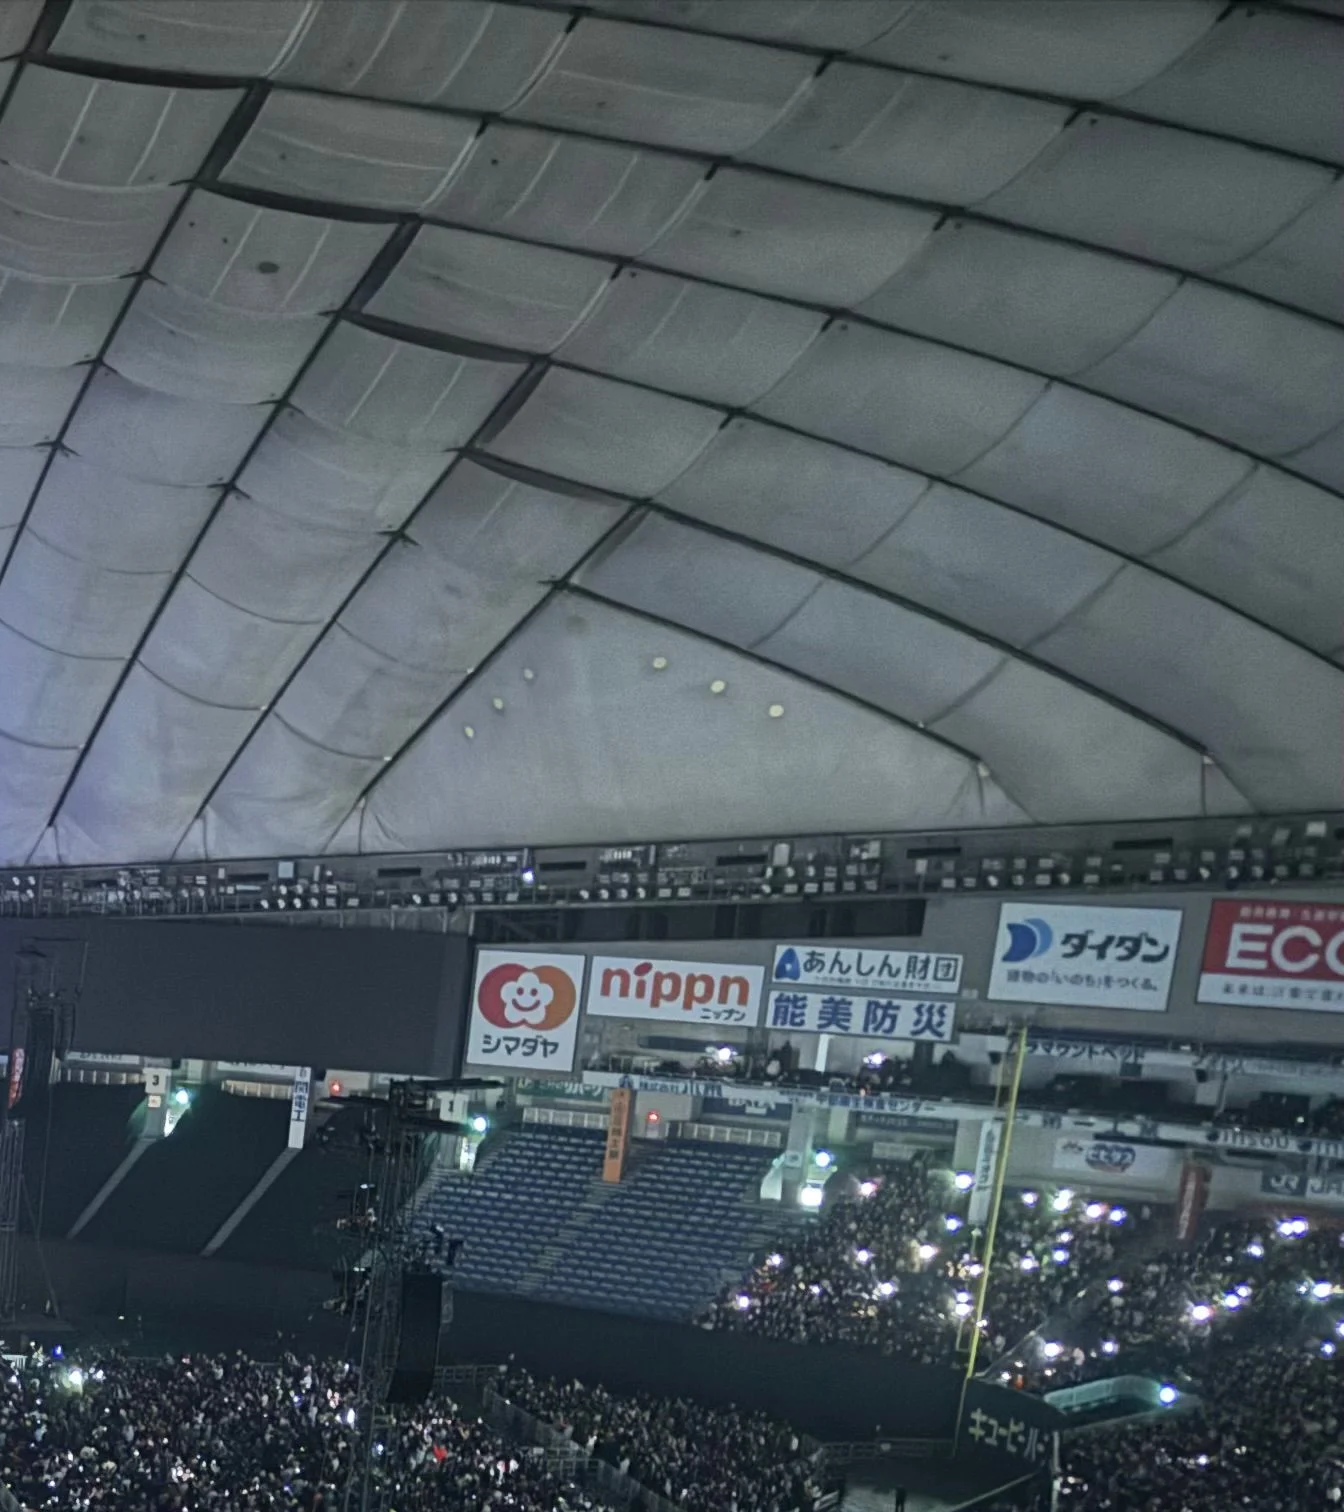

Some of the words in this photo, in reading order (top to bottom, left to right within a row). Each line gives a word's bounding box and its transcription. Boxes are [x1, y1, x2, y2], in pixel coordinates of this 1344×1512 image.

[1060, 929, 1169, 963] ダイダン
[803, 950, 958, 982] あんしん財団
[600, 962, 750, 1010] nippn
[700, 1008, 746, 1022] ニップン
[772, 993, 948, 1038] 能美防災
[481, 1034, 559, 1058] シマダヤ
[152, 1075, 160, 1086] 3
